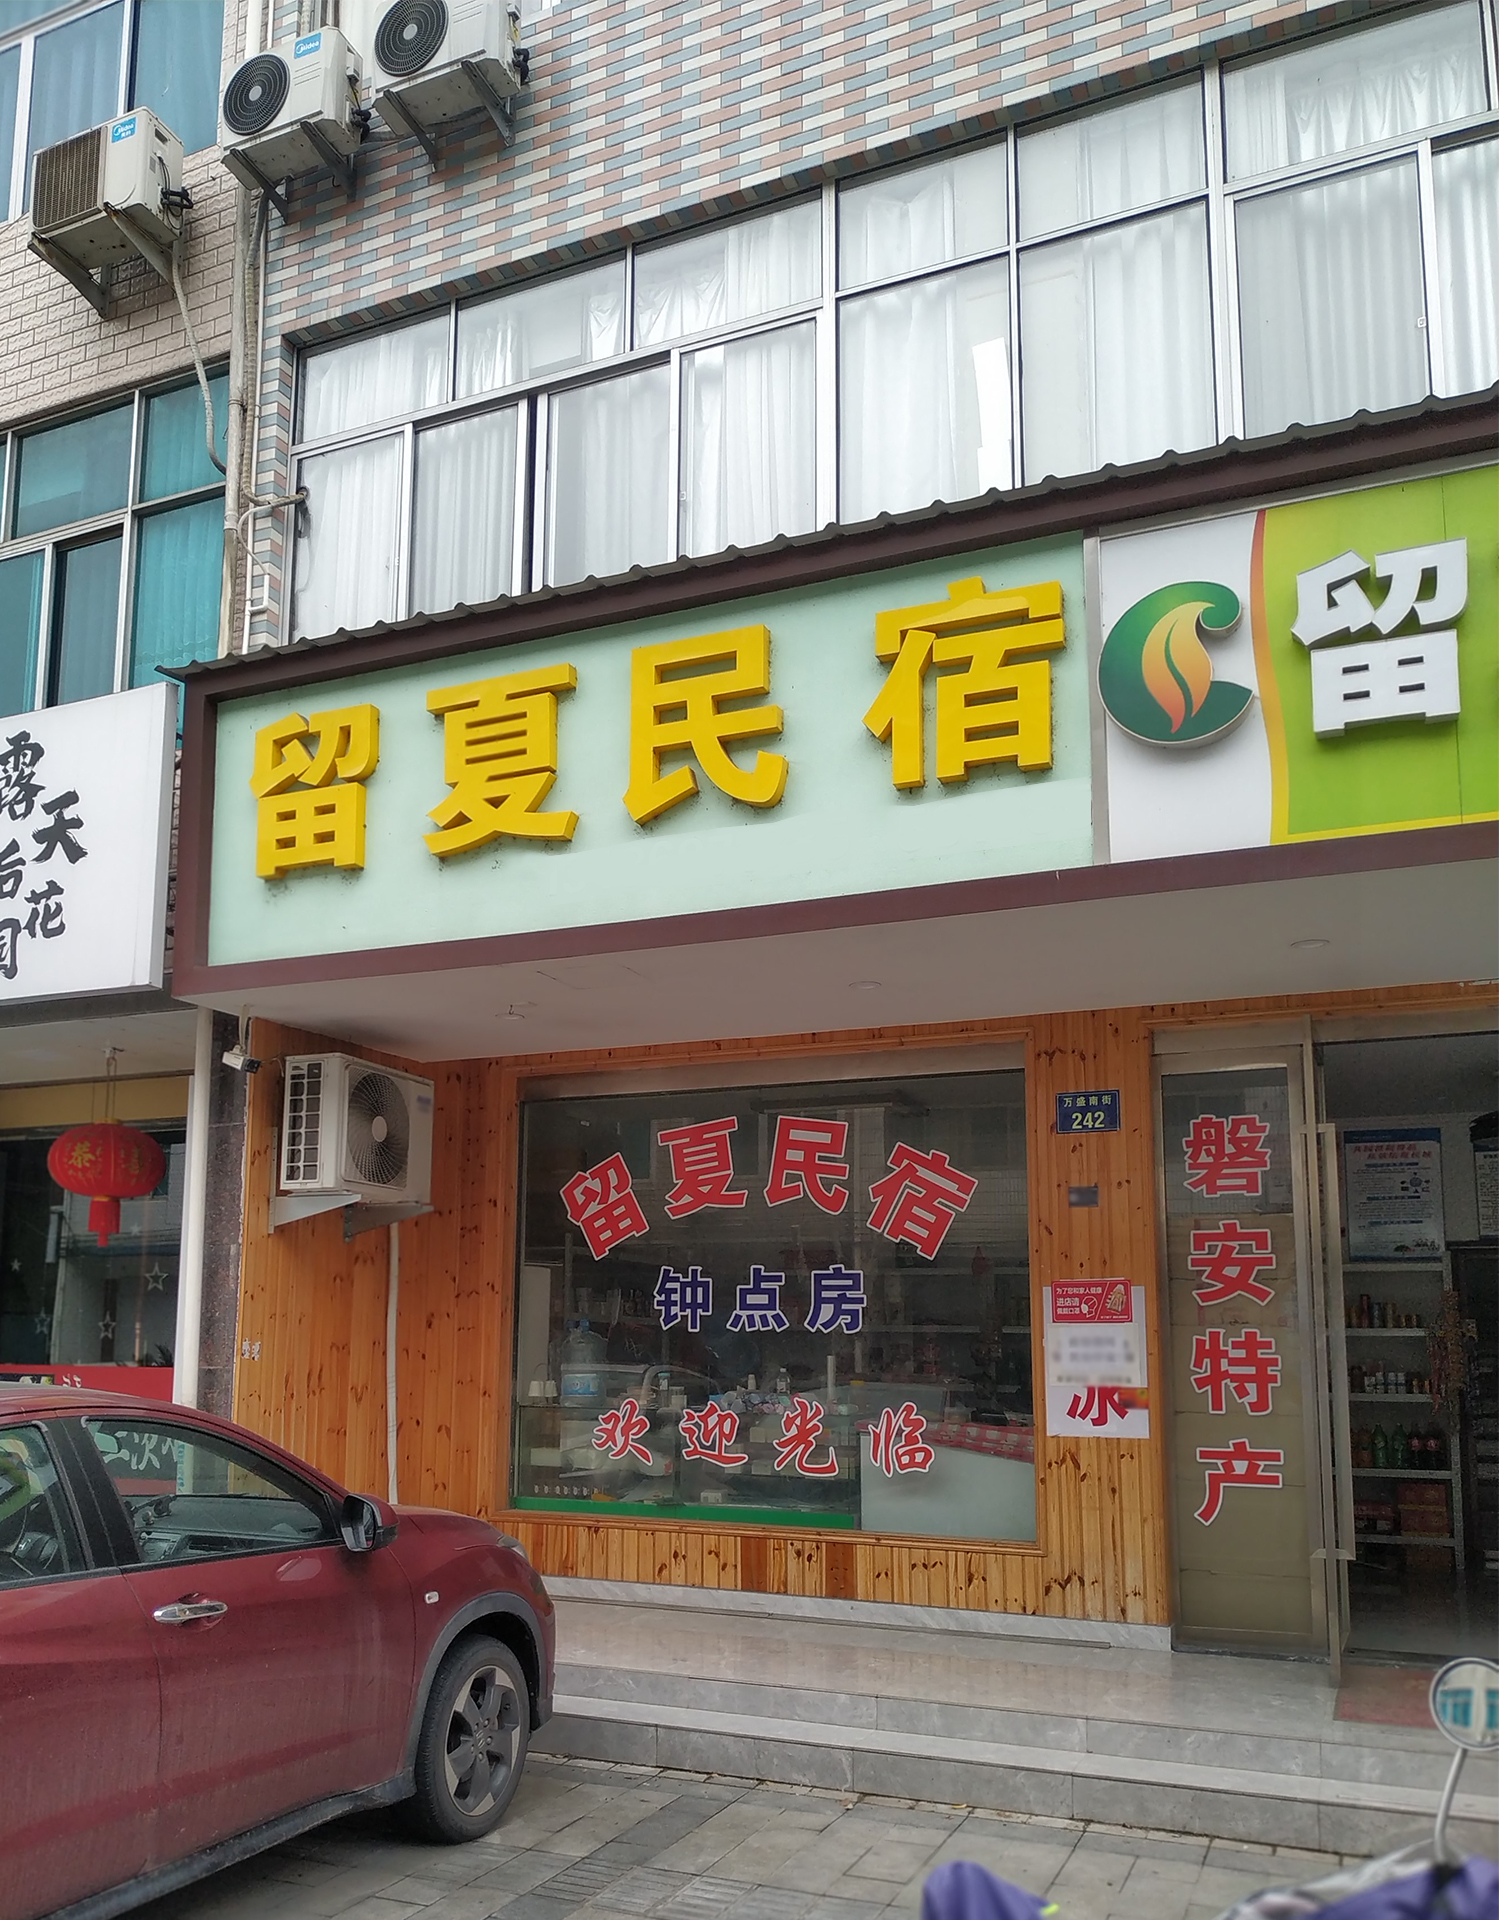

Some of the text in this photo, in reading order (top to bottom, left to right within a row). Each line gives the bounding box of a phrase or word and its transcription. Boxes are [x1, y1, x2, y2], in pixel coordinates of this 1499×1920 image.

[1290, 537, 1469, 739] 留
[250, 576, 1066, 881] 留夏民宿
[1063, 1094, 1112, 1108] 万盛南街
[1072, 1111, 1105, 1129] 242
[559, 1115, 979, 1261] 留夏民宿
[653, 1264, 867, 1334] 钟点房
[1181, 1113, 1285, 1527] 磐安特产
[591, 1396, 937, 1479] 欢迎光临
